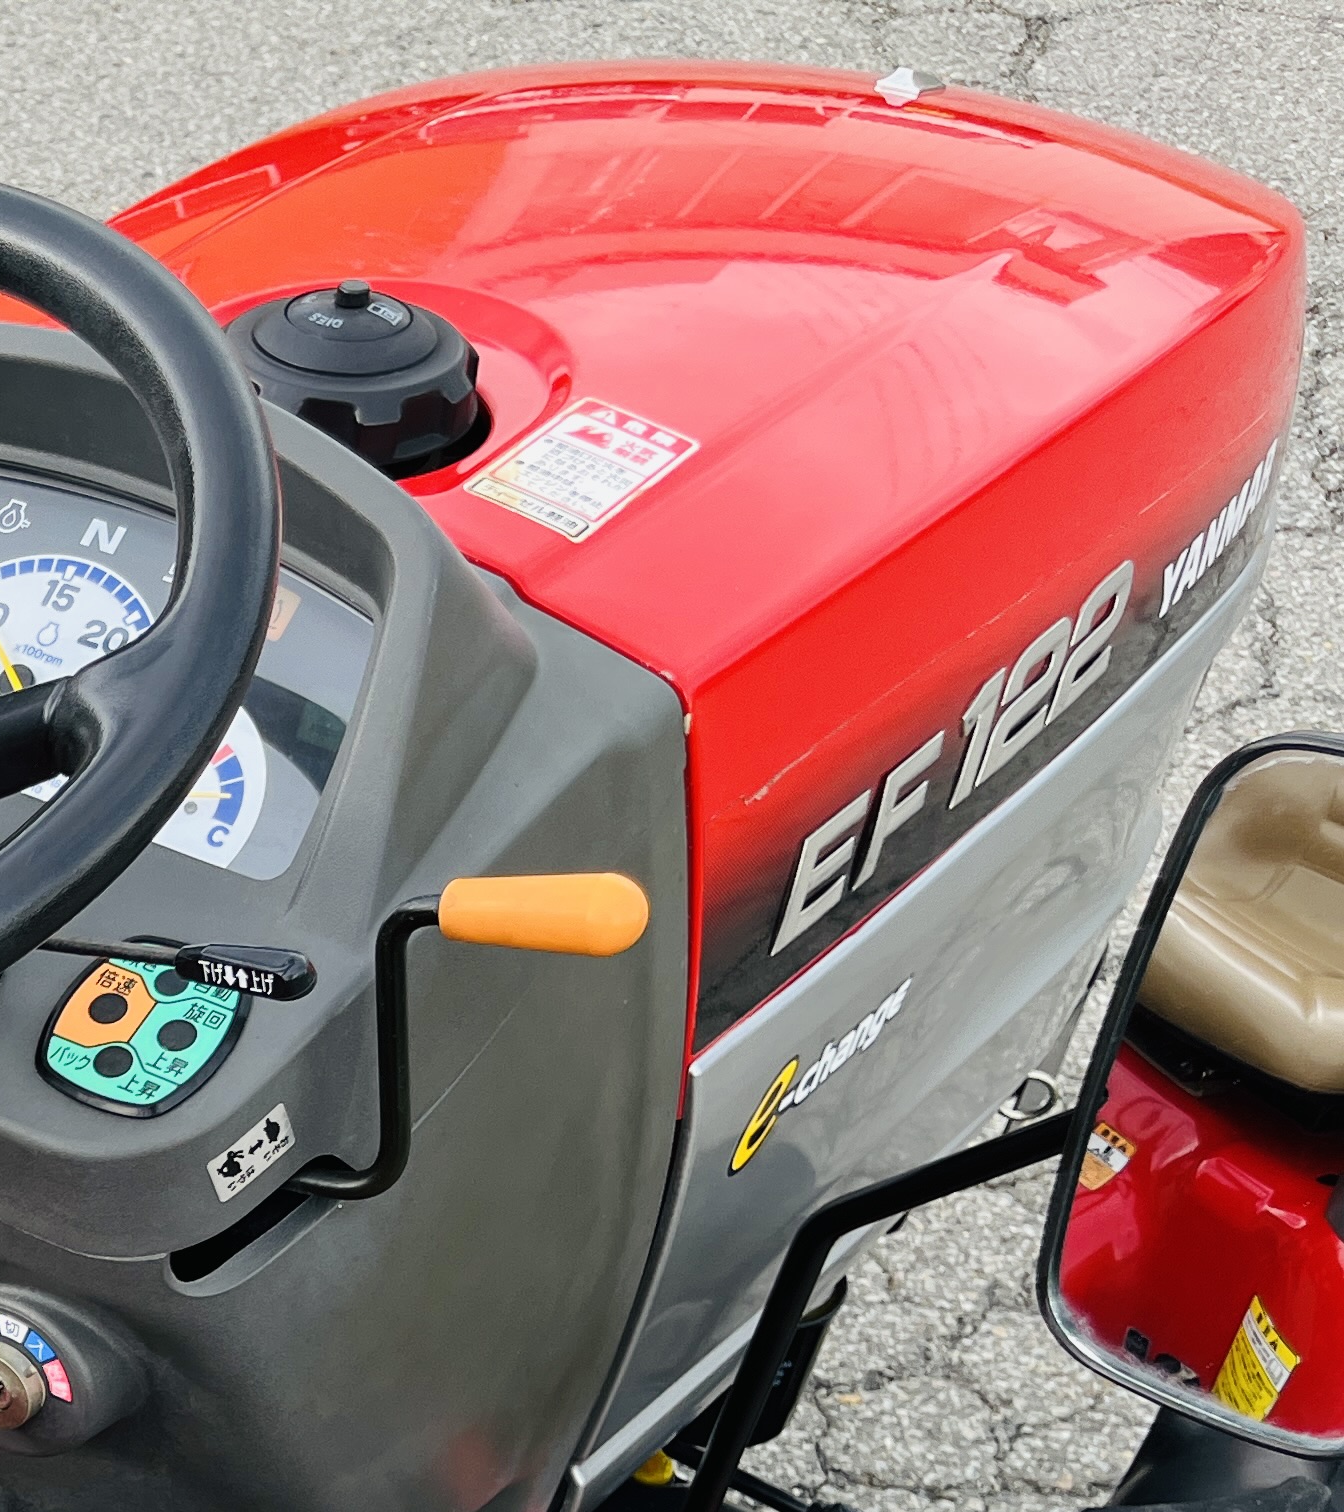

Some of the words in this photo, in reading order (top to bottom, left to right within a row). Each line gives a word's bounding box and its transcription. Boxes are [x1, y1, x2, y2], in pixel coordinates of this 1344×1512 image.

[80, 518, 127, 555] N
[1159, 438, 1278, 619] YANMAR
[40, 579, 81, 612] 15
[77, 620, 130, 653] 20
[770, 730, 945, 956] EF
[949, 560, 1133, 810] 122
[207, 825, 230, 848] C
[96, 969, 139, 996] 倍速
[198, 960, 225, 984] 下げ
[249, 972, 275, 996] 上げ
[183, 1002, 227, 1029] 旋回
[49, 1046, 91, 1070] バック
[146, 1052, 189, 1078] 上昇
[117, 1074, 161, 1100] 上昇
[728, 974, 913, 1177] e-change
